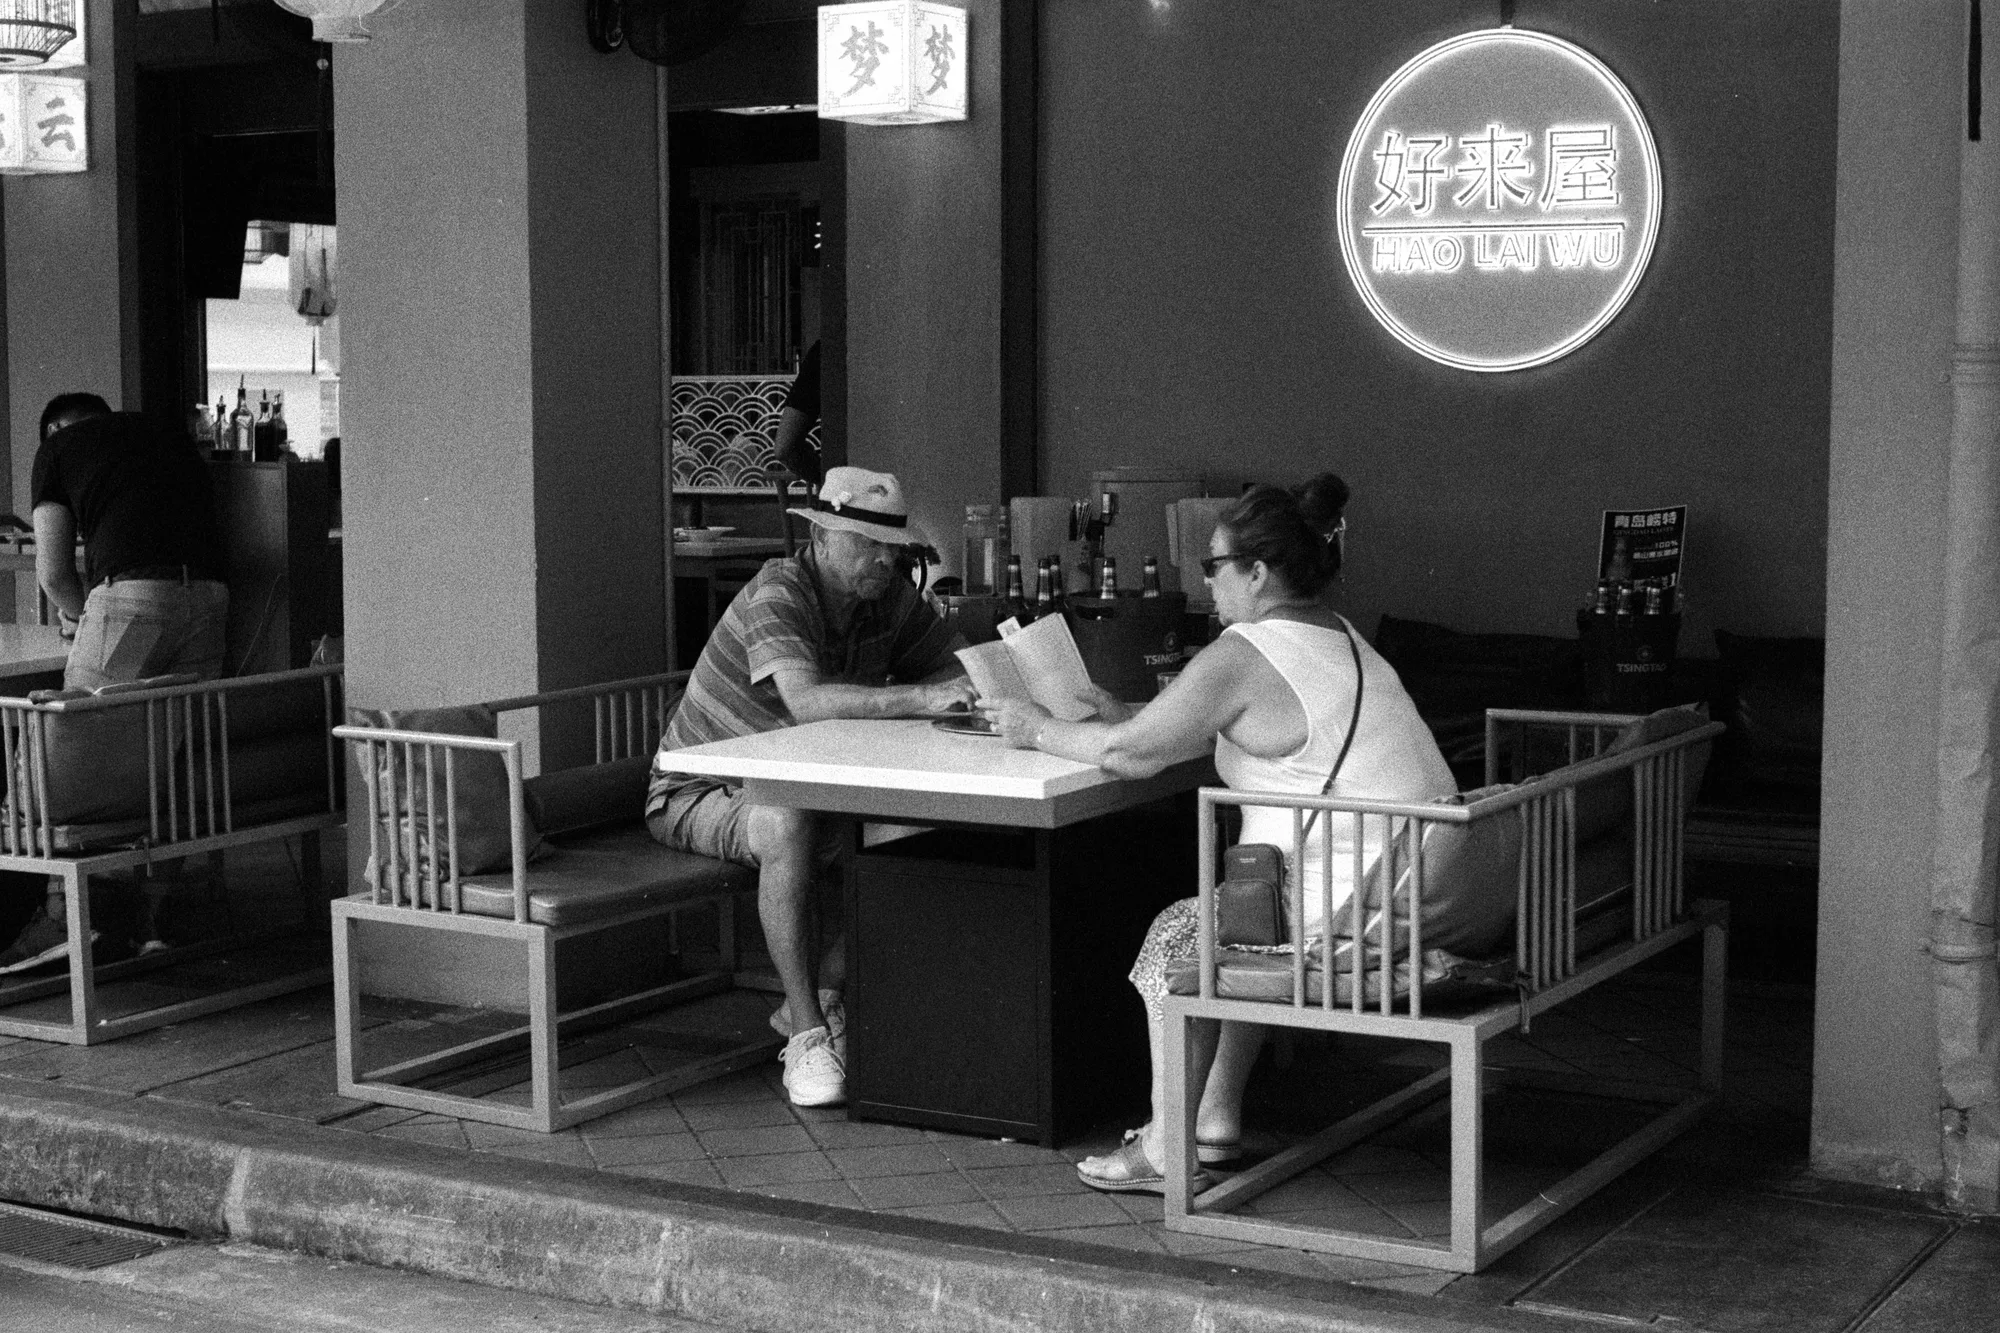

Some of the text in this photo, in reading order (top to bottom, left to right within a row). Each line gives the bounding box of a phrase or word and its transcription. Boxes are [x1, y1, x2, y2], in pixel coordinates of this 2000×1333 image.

[37, 97, 75, 152] 云
[1369, 122, 1622, 216] 好来屋
[1373, 231, 1623, 272] HAO LAI WU
[1616, 663, 1667, 673] TSINGTAO
